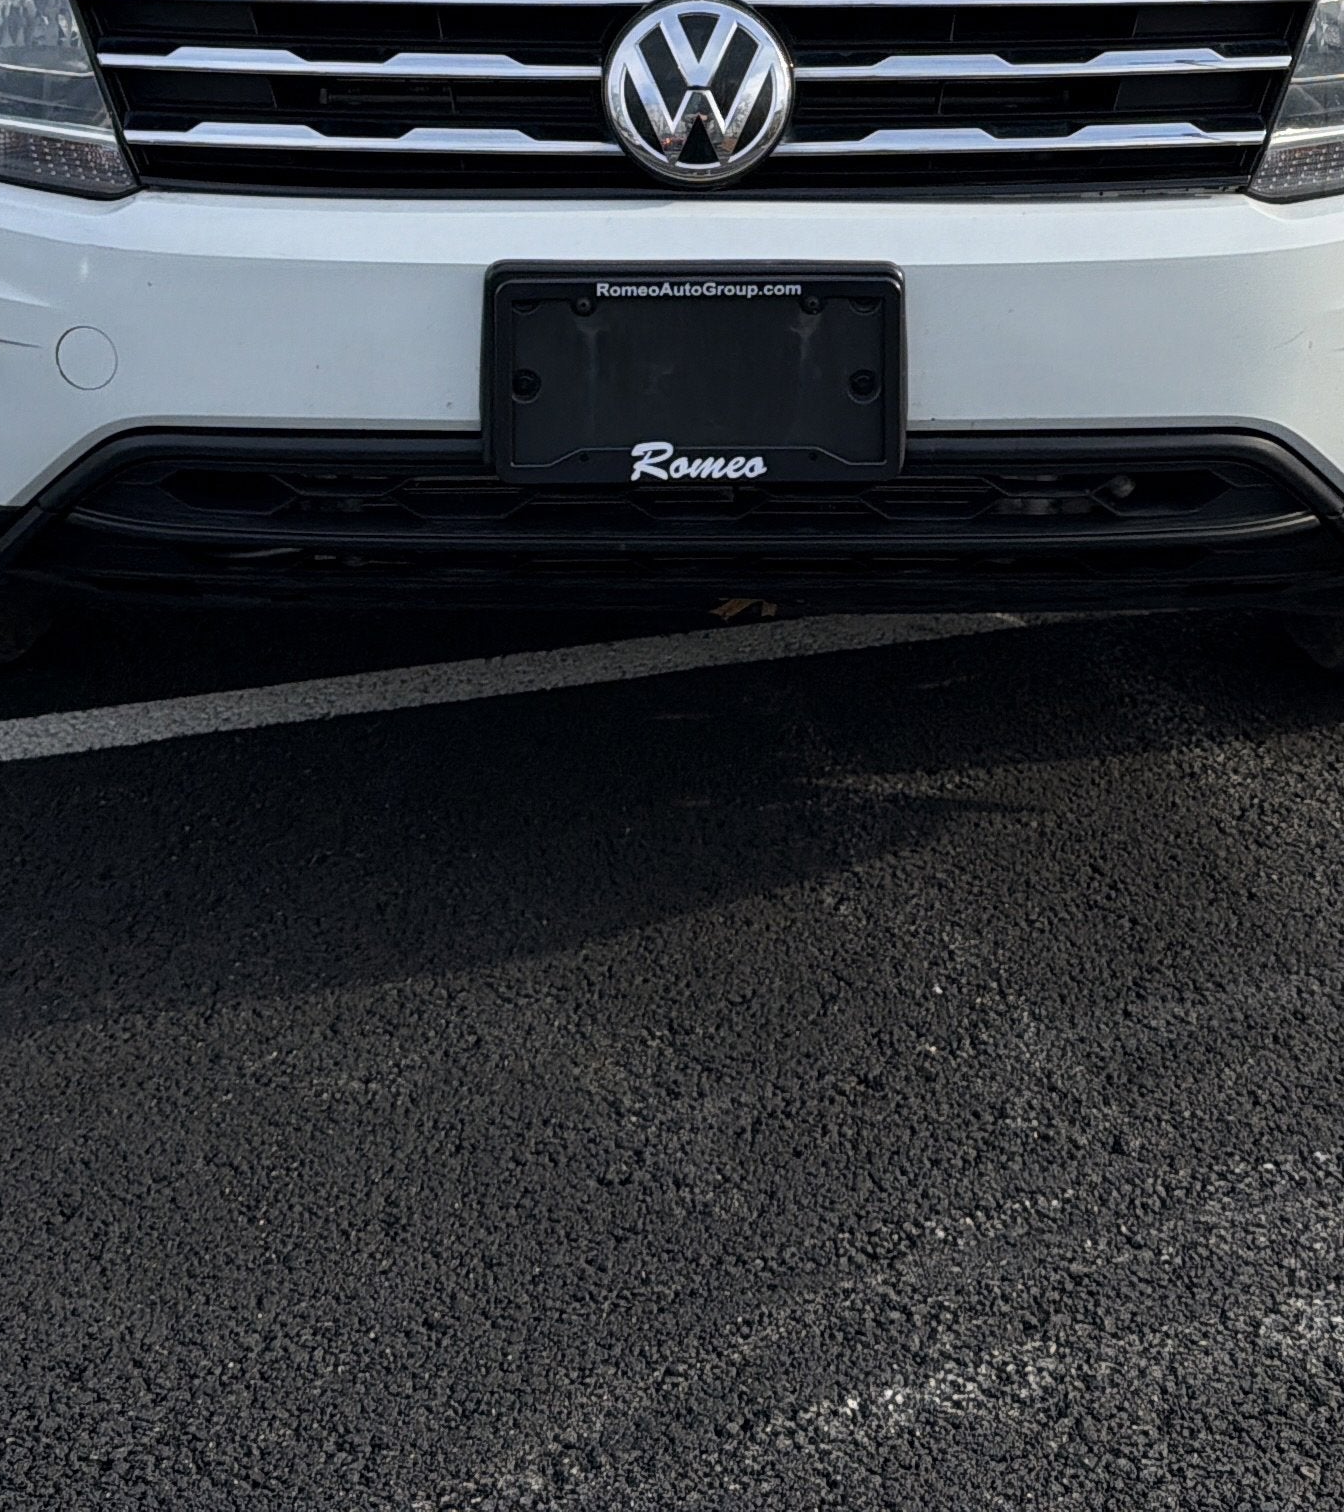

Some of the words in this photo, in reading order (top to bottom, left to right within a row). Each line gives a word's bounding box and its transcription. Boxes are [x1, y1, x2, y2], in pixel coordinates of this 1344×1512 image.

[609, 0, 792, 180] VW
[595, 282, 803, 299] RomeoAutoGroup.com
[630, 441, 768, 482] Romeo
